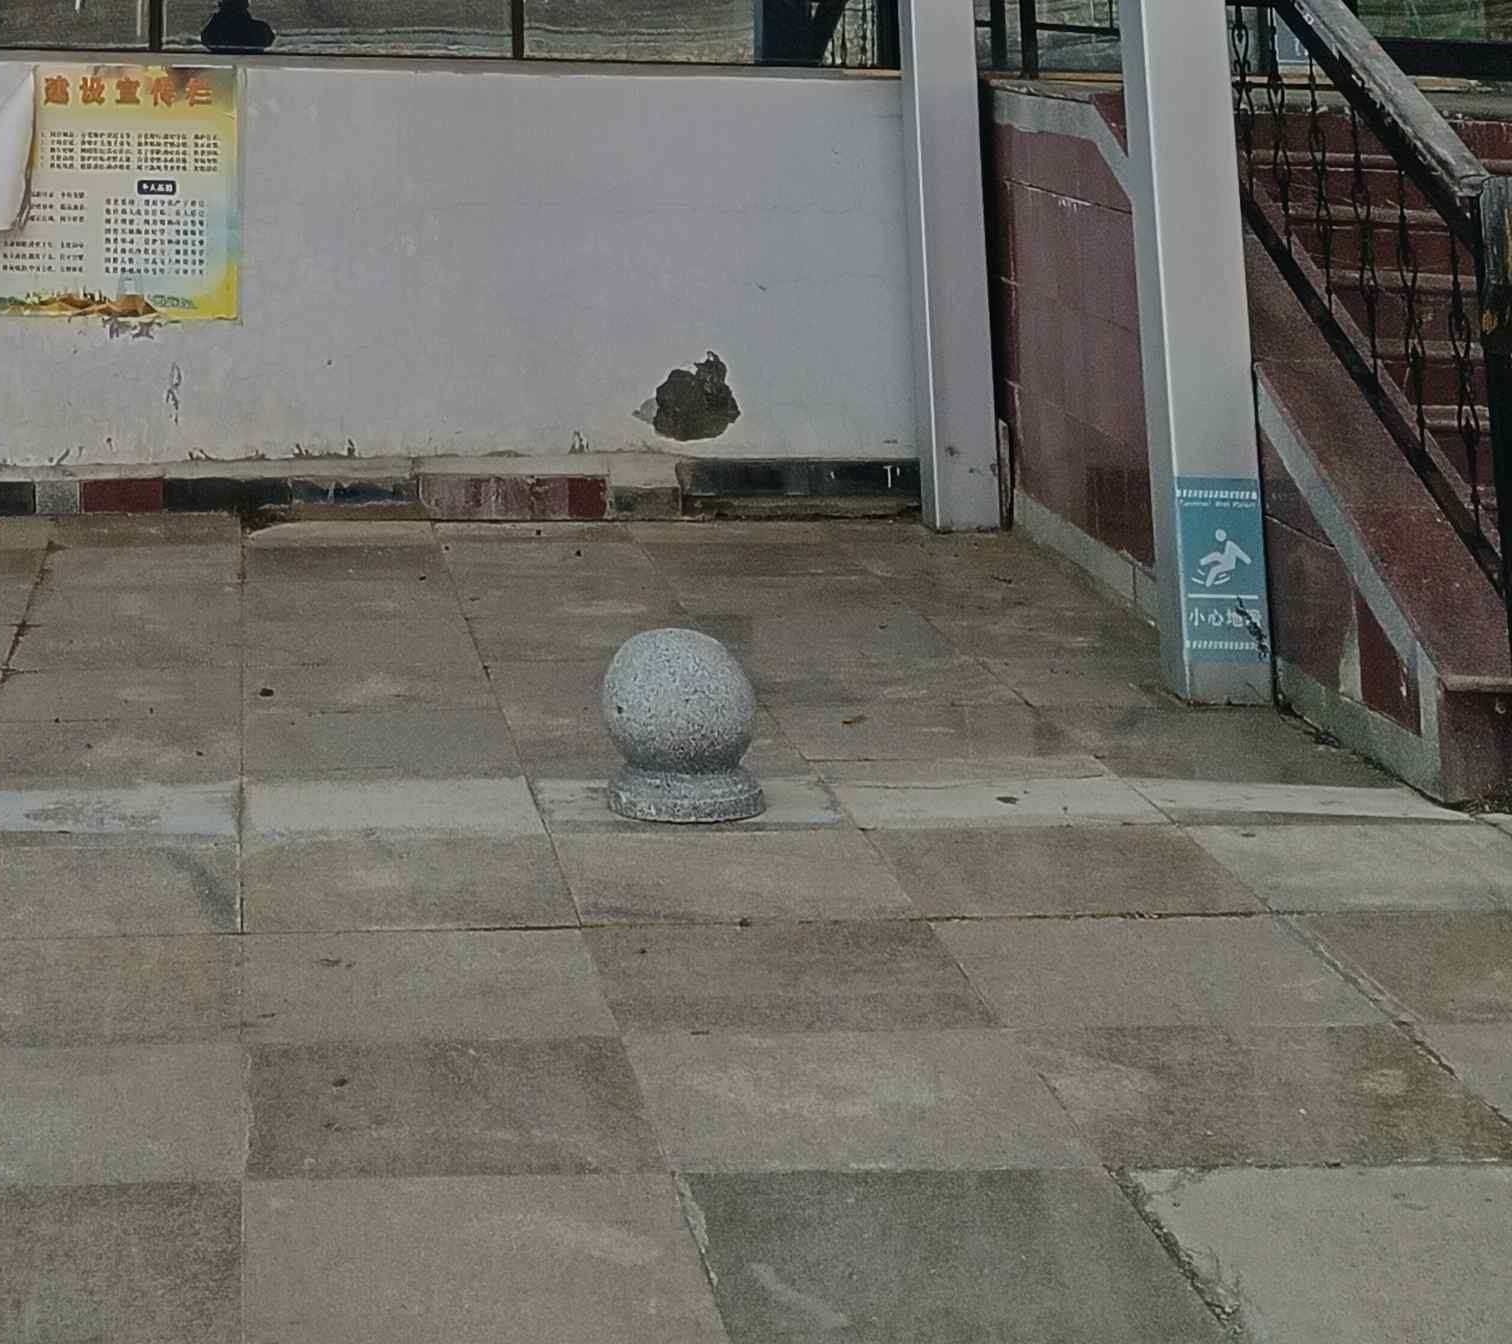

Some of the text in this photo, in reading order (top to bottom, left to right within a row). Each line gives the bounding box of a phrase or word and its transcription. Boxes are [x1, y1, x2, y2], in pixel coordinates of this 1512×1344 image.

[44, 75, 213, 107] 建设宣传栏
